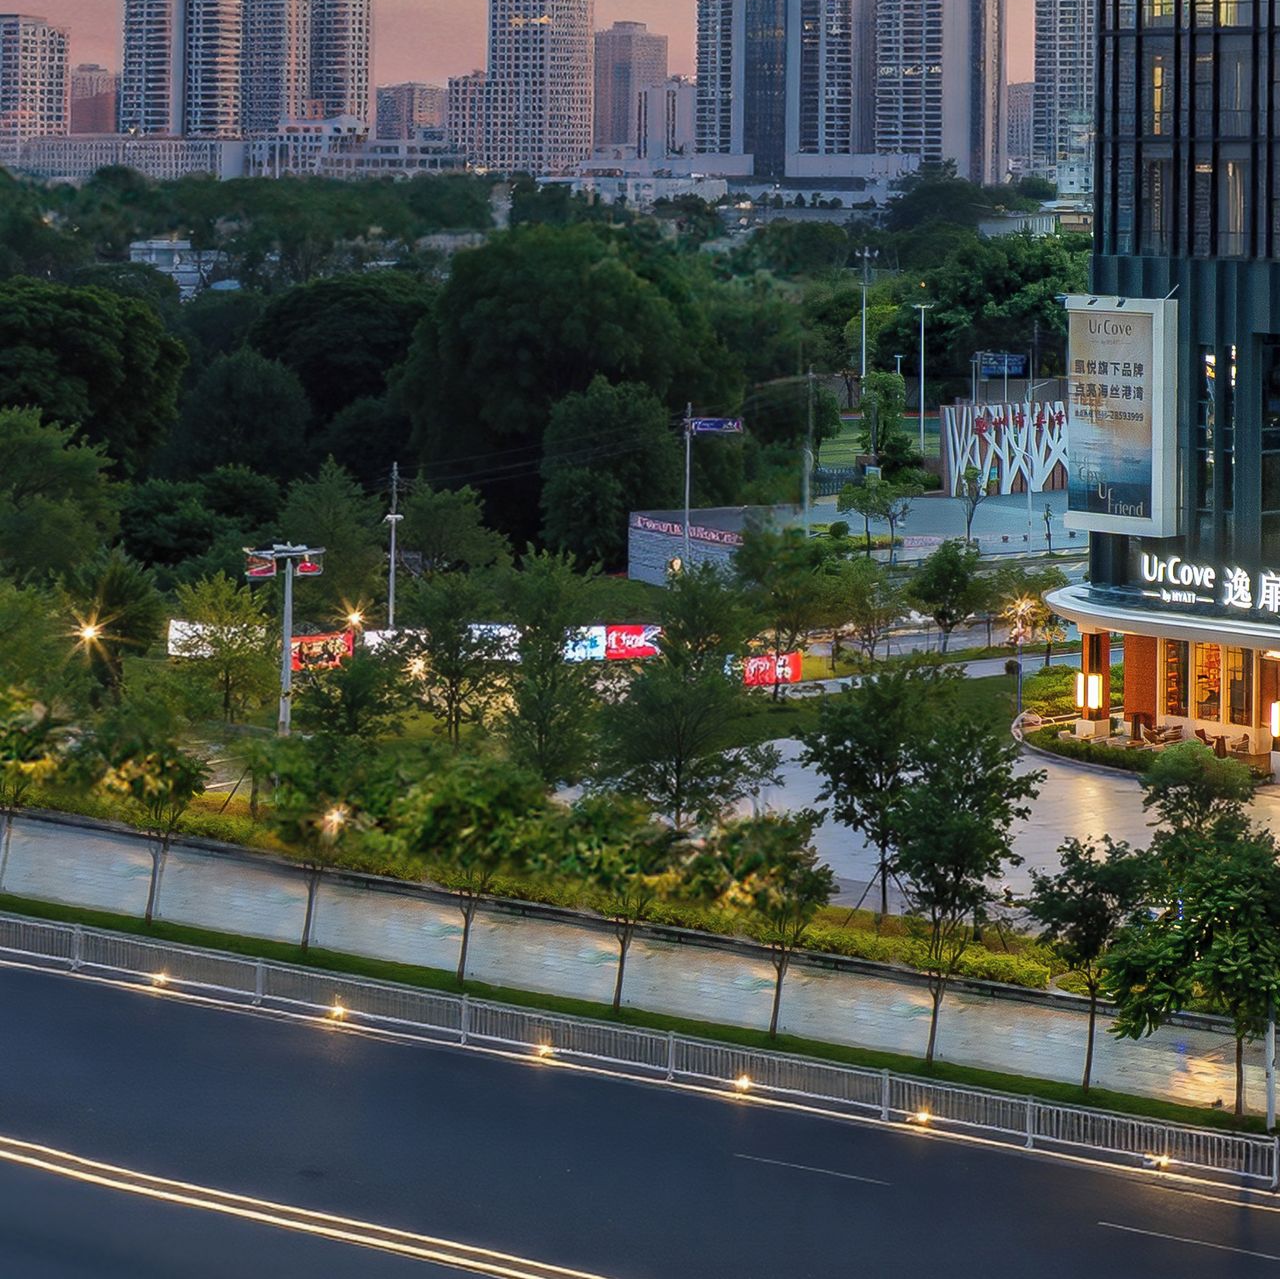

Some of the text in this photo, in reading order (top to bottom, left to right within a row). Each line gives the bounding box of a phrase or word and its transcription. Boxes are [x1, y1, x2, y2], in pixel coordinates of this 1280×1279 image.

[1088, 319, 1132, 336] UrCove
[1074, 359, 1144, 377] 凯悦旗下品牌
[1074, 381, 1144, 401] 点亮海丝港湾
[1107, 497, 1144, 516] Friend
[1141, 553, 1216, 589] UrCove
[1172, 590, 1196, 603] HYATT
